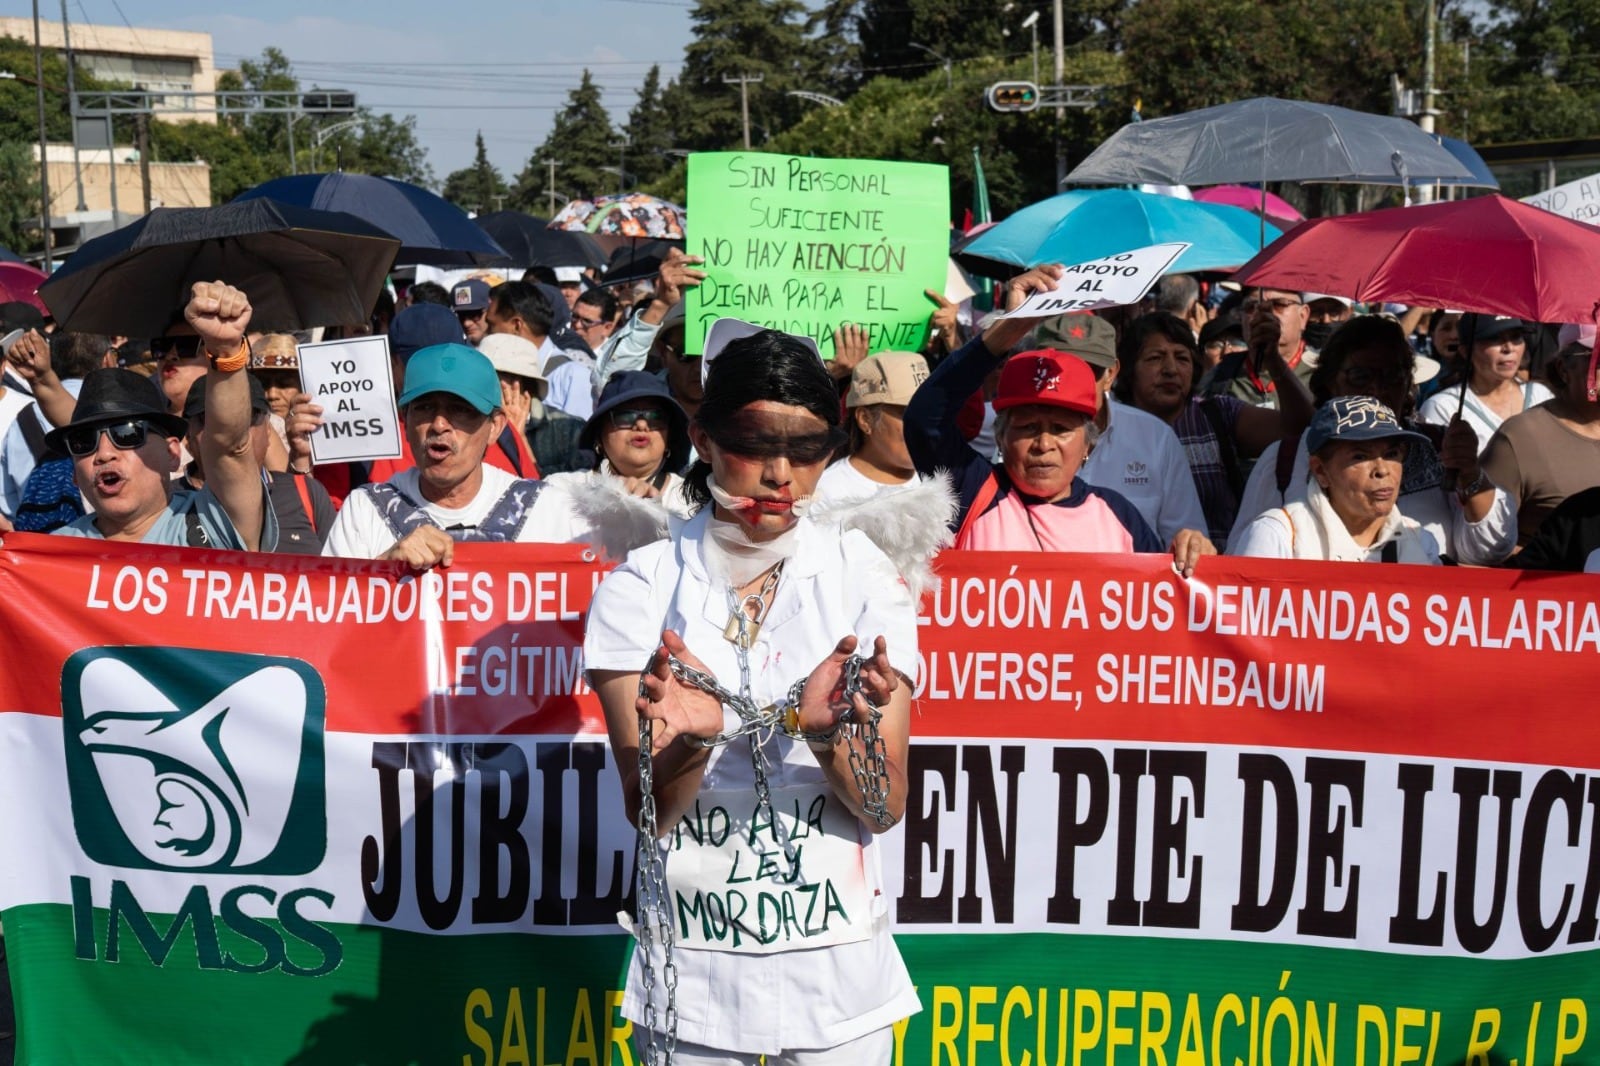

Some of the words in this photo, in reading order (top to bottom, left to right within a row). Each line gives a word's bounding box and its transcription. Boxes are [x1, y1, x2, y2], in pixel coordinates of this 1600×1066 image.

[788, 158, 891, 196] PERSONAL
[749, 198, 883, 232] SUFICIENTE
[703, 237, 733, 267] NO
[746, 238, 787, 270] HAY
[793, 237, 905, 272] ATENCIÓN
[1066, 264, 1139, 277] APOYO
[700, 275, 772, 308] DIGNA
[783, 278, 844, 312] PARA
[867, 285, 898, 312] EL
[1035, 299, 1098, 310] IMS
[1075, 279, 1104, 292] AL
[331, 360, 356, 374] YO
[318, 379, 373, 395] APOYO
[337, 398, 360, 412] AL
[323, 418, 384, 439] IMSS
[86, 564, 169, 615] LOS
[182, 568, 494, 623] TRABAJADORES
[507, 572, 580, 621] DEL
[917, 565, 1052, 628] UCIÓN
[1062, 580, 1089, 630] A
[1099, 580, 1175, 632] SUS
[1188, 584, 1410, 645] DEMANDAS
[430, 633, 590, 695] LEGÍTIM
[1096, 653, 1325, 713] SHEINBAUM
[361, 742, 638, 930] JUBIL
[675, 798, 731, 850] NO
[749, 802, 778, 846] A
[788, 794, 827, 841] LA
[896, 744, 1026, 924] EN
[1047, 746, 1207, 929] PIE
[1230, 752, 1366, 939] DE
[726, 844, 803, 884] LEY
[70, 875, 343, 977] IMSS
[675, 878, 852, 948] MORDAZA
[463, 987, 644, 1066] SALAR
